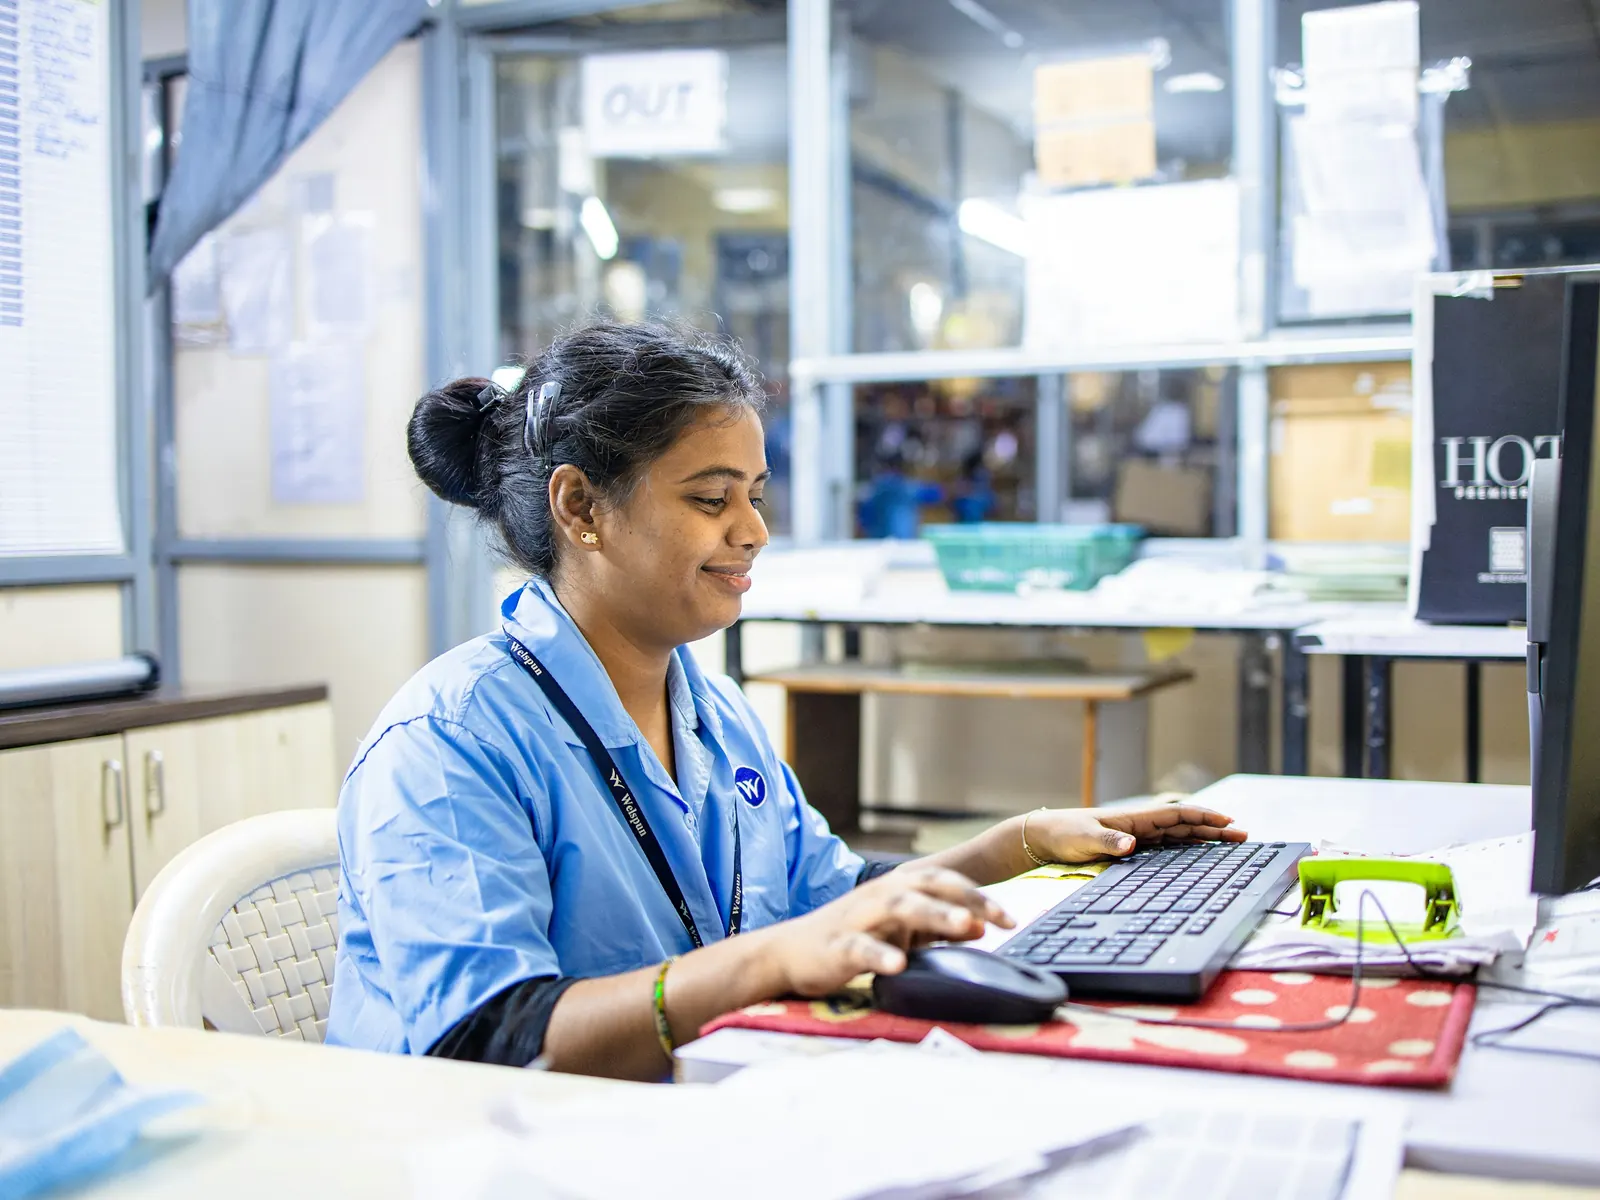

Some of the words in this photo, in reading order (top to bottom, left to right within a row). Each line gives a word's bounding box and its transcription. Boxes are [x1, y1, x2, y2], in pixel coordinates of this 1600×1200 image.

[601, 82, 695, 123] OUT
[510, 641, 542, 676] Welspun
[621, 792, 647, 837] Welspun
[732, 873, 742, 914] Welspun
[689, 925, 701, 948] Wel
